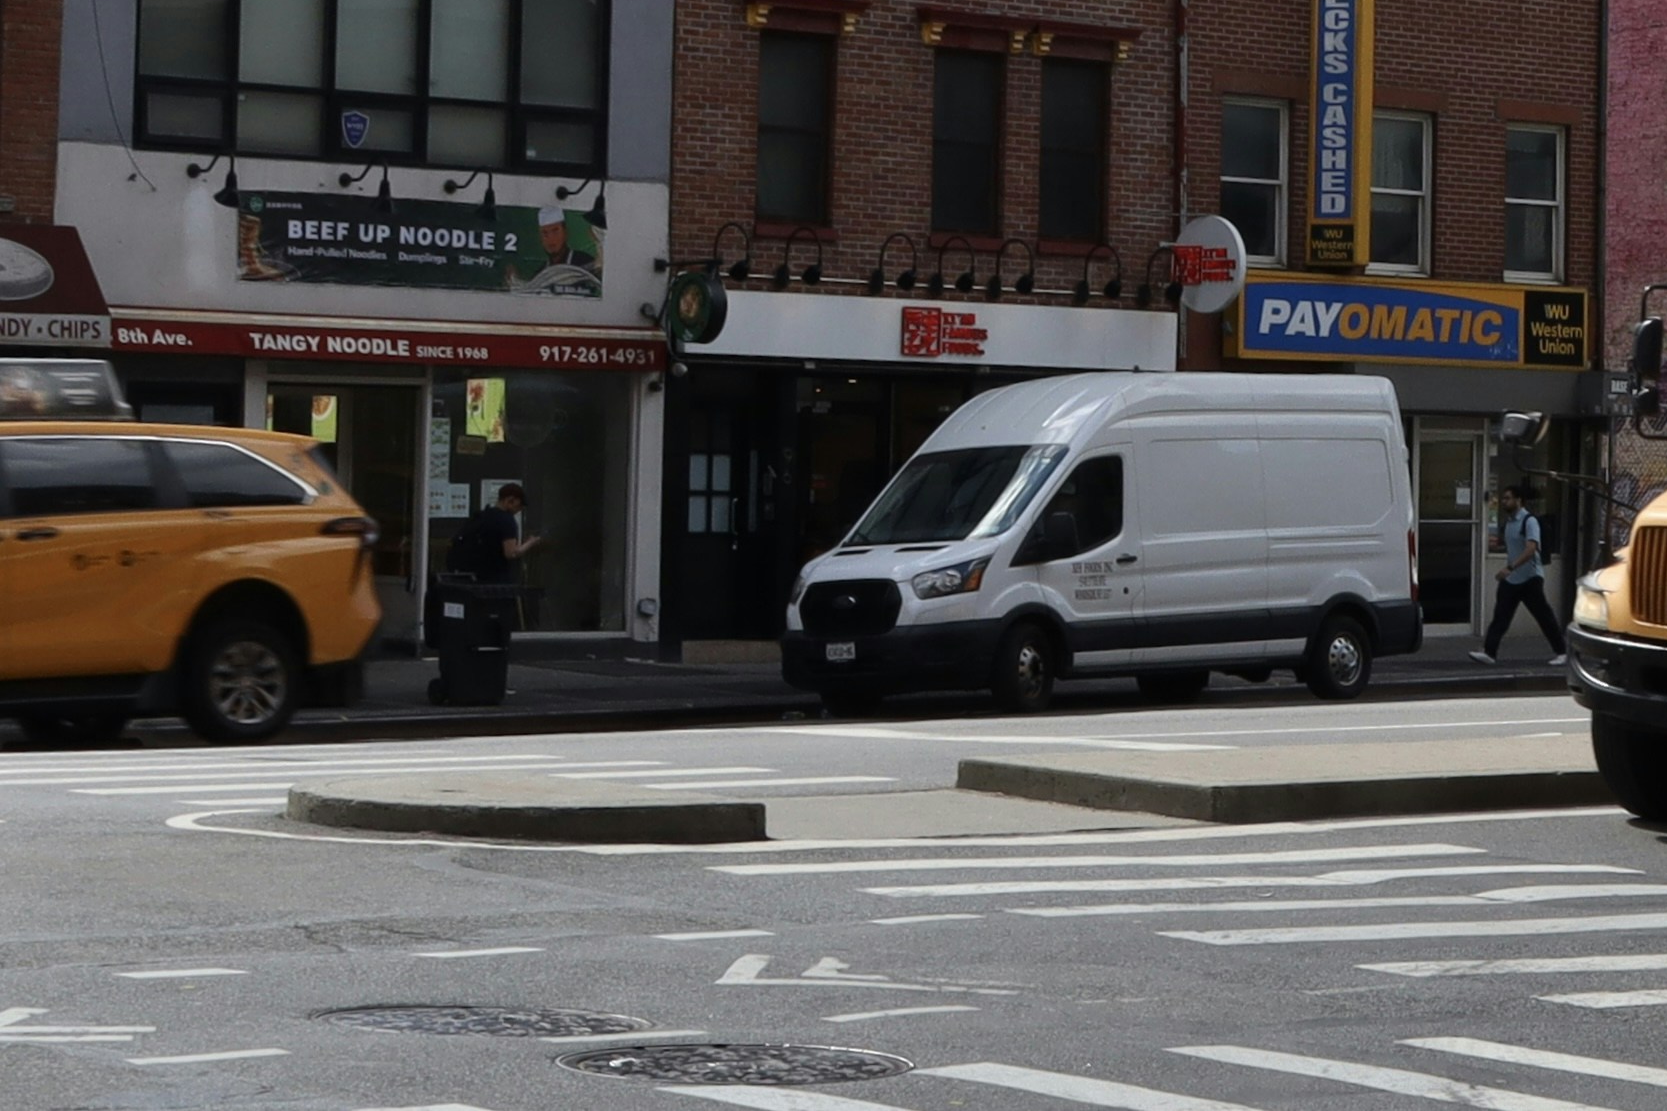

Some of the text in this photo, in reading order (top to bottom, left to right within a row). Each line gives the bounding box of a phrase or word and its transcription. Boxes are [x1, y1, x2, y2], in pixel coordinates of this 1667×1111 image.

[1320, 83, 1348, 215] CASHED
[287, 219, 518, 252] BEEF UP NOODLE 2
[1312, 239, 1354, 251] Western
[347, 247, 388, 261] Noodles
[398, 251, 447, 266] Dumplings
[458, 255, 495, 269] Stir-Fry
[1317, 249, 1348, 260] Union
[1543, 303, 1570, 321] WU
[47, 319, 101, 339] CHIPS
[1258, 298, 1504, 346] PAYOMATIC
[1530, 321, 1583, 338] Western
[117, 327, 193, 346] 8th Ave.
[249, 331, 656, 366] TANGY NOODLE SINCE 1968 917-261-4931
[1538, 338, 1575, 356] Union
